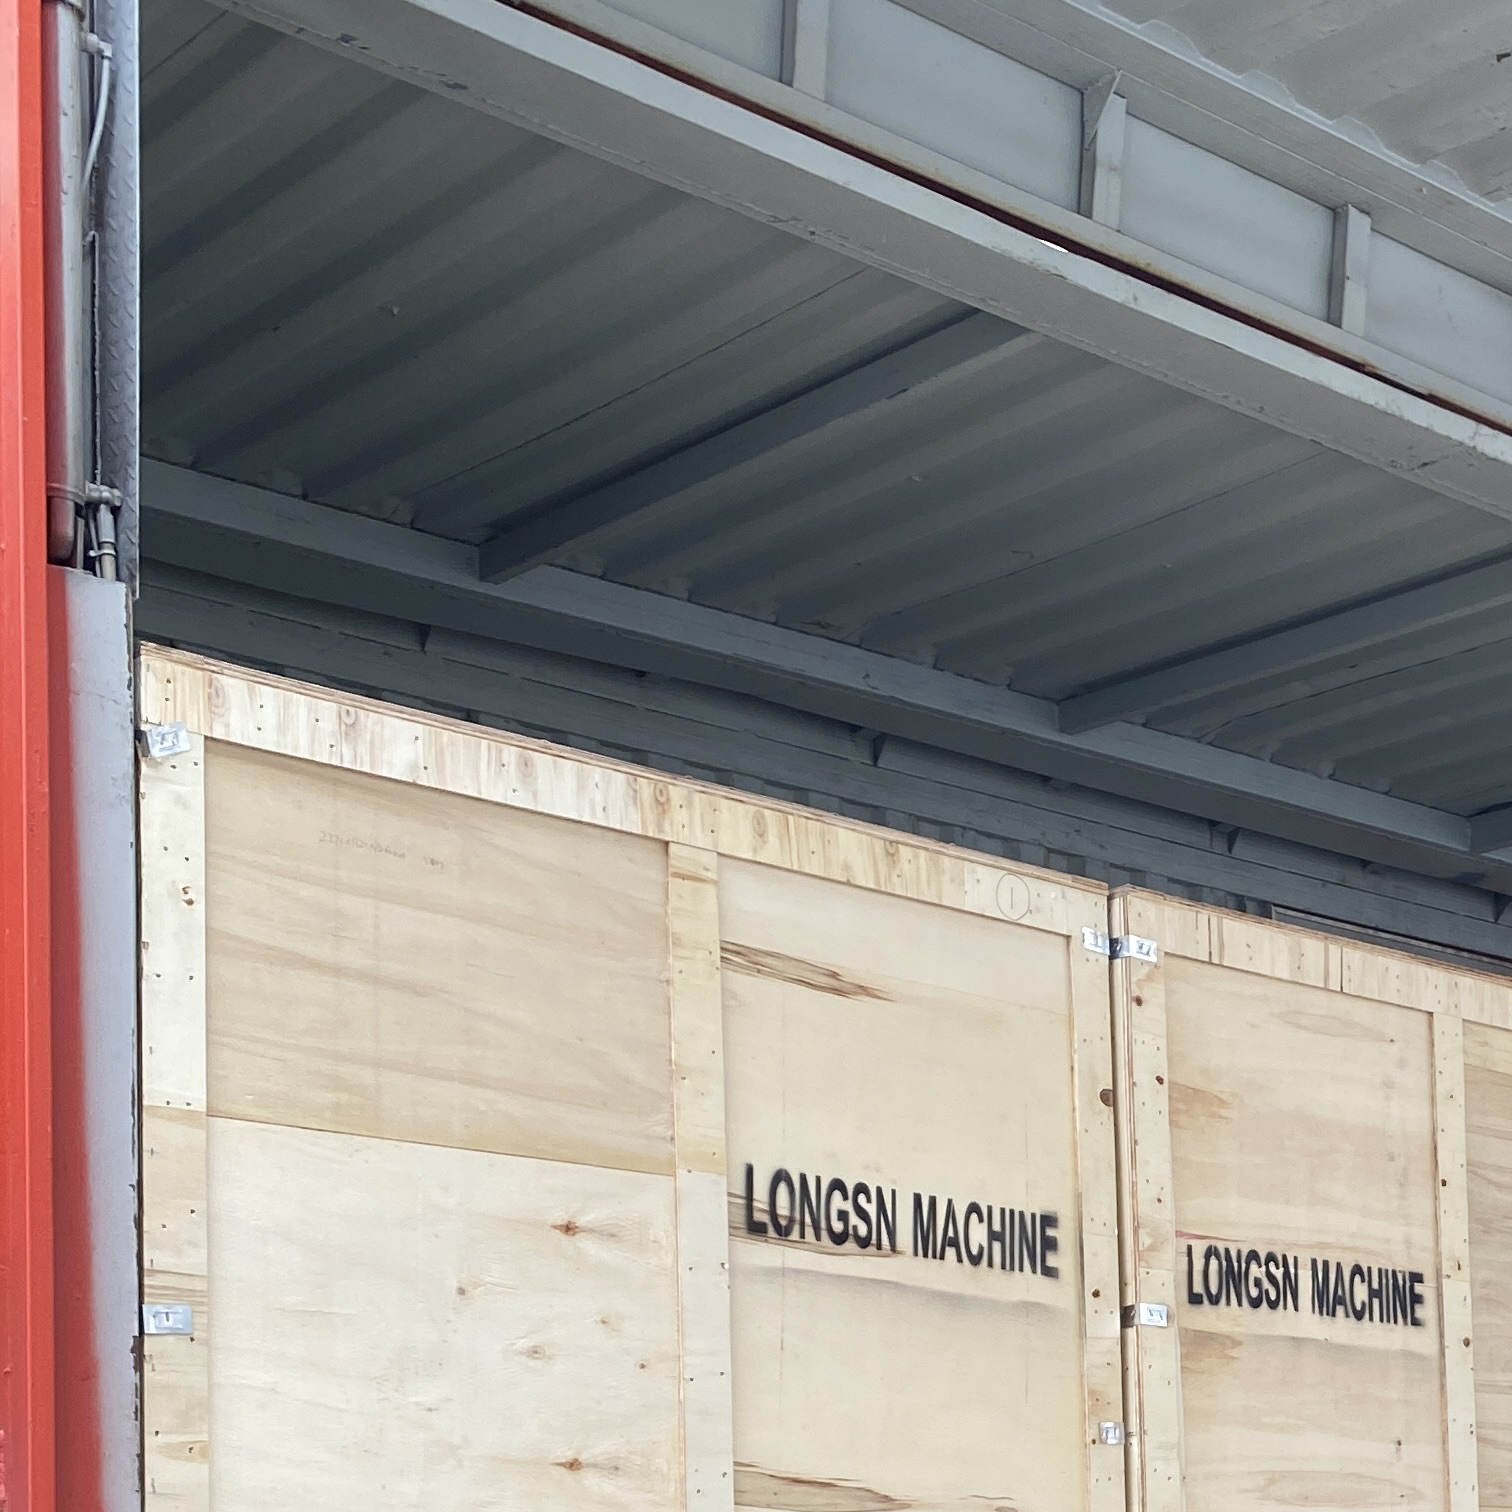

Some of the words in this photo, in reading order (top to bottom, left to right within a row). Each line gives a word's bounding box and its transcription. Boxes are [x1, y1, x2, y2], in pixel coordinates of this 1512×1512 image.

[745, 1163, 897, 1252] LONGSN
[912, 1192, 1059, 1279] MACHINE
[1187, 1244, 1299, 1312] LONGSN
[1311, 1258, 1425, 1327] MACHINE
